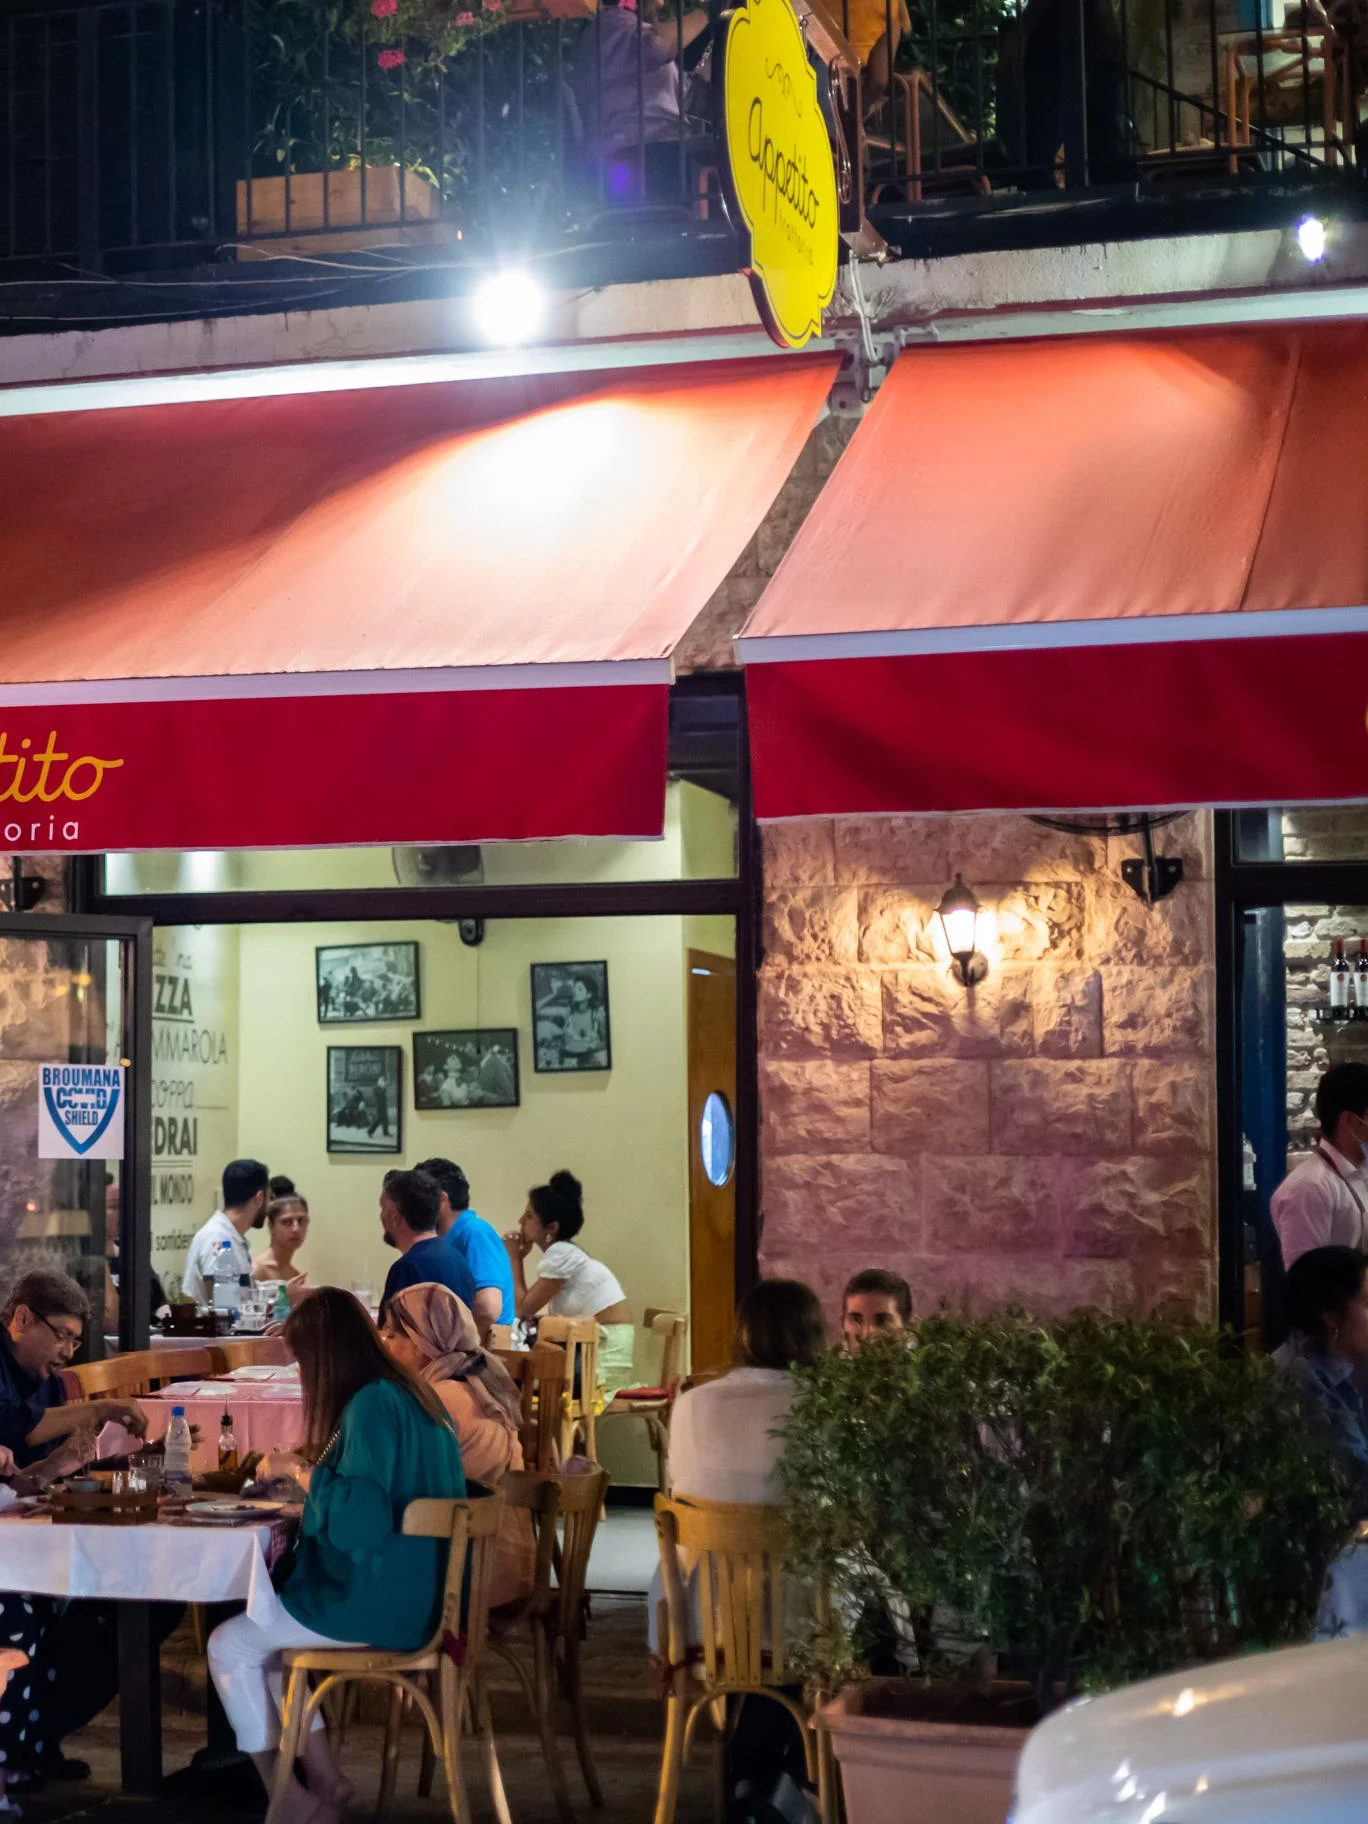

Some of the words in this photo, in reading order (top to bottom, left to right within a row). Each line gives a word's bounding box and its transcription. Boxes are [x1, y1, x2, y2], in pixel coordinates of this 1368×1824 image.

[748, 97, 820, 230] Appetito
[154, 974, 193, 1016] ZZA
[151, 1026, 229, 1065] MMAROLA
[42, 1066, 121, 1088] BROUMANA
[64, 1111, 99, 1126] SHIELD
